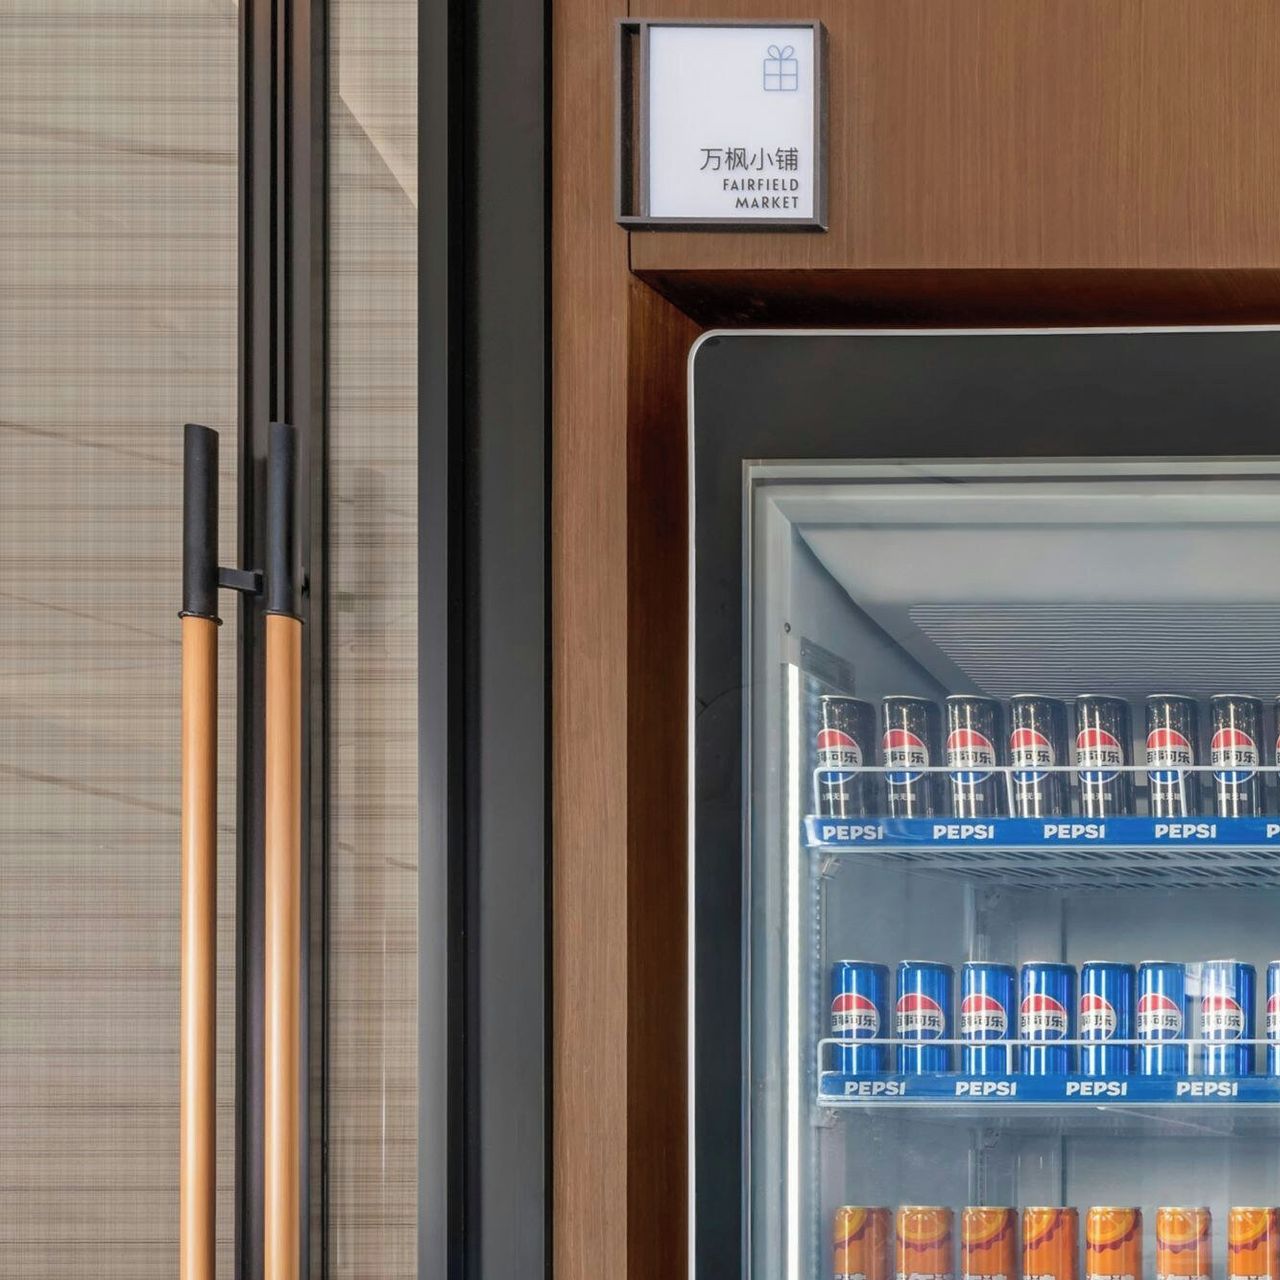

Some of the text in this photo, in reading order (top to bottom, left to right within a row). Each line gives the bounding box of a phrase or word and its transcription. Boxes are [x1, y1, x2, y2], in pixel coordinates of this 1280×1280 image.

[700, 147, 799, 171] 万枫小铺
[723, 178, 799, 191] FAIRFIELD
[735, 196, 799, 209] MARKET
[823, 826, 884, 840] PEPSI
[933, 825, 994, 839] PEPSI
[1044, 825, 1105, 839] PEPSI
[1155, 824, 1216, 838] PEPSI
[844, 1082, 905, 1095] PEPSI
[955, 1081, 1016, 1096] PEPSI
[1066, 1081, 1127, 1096] PEPSI
[1177, 1081, 1238, 1096] PEPSI
